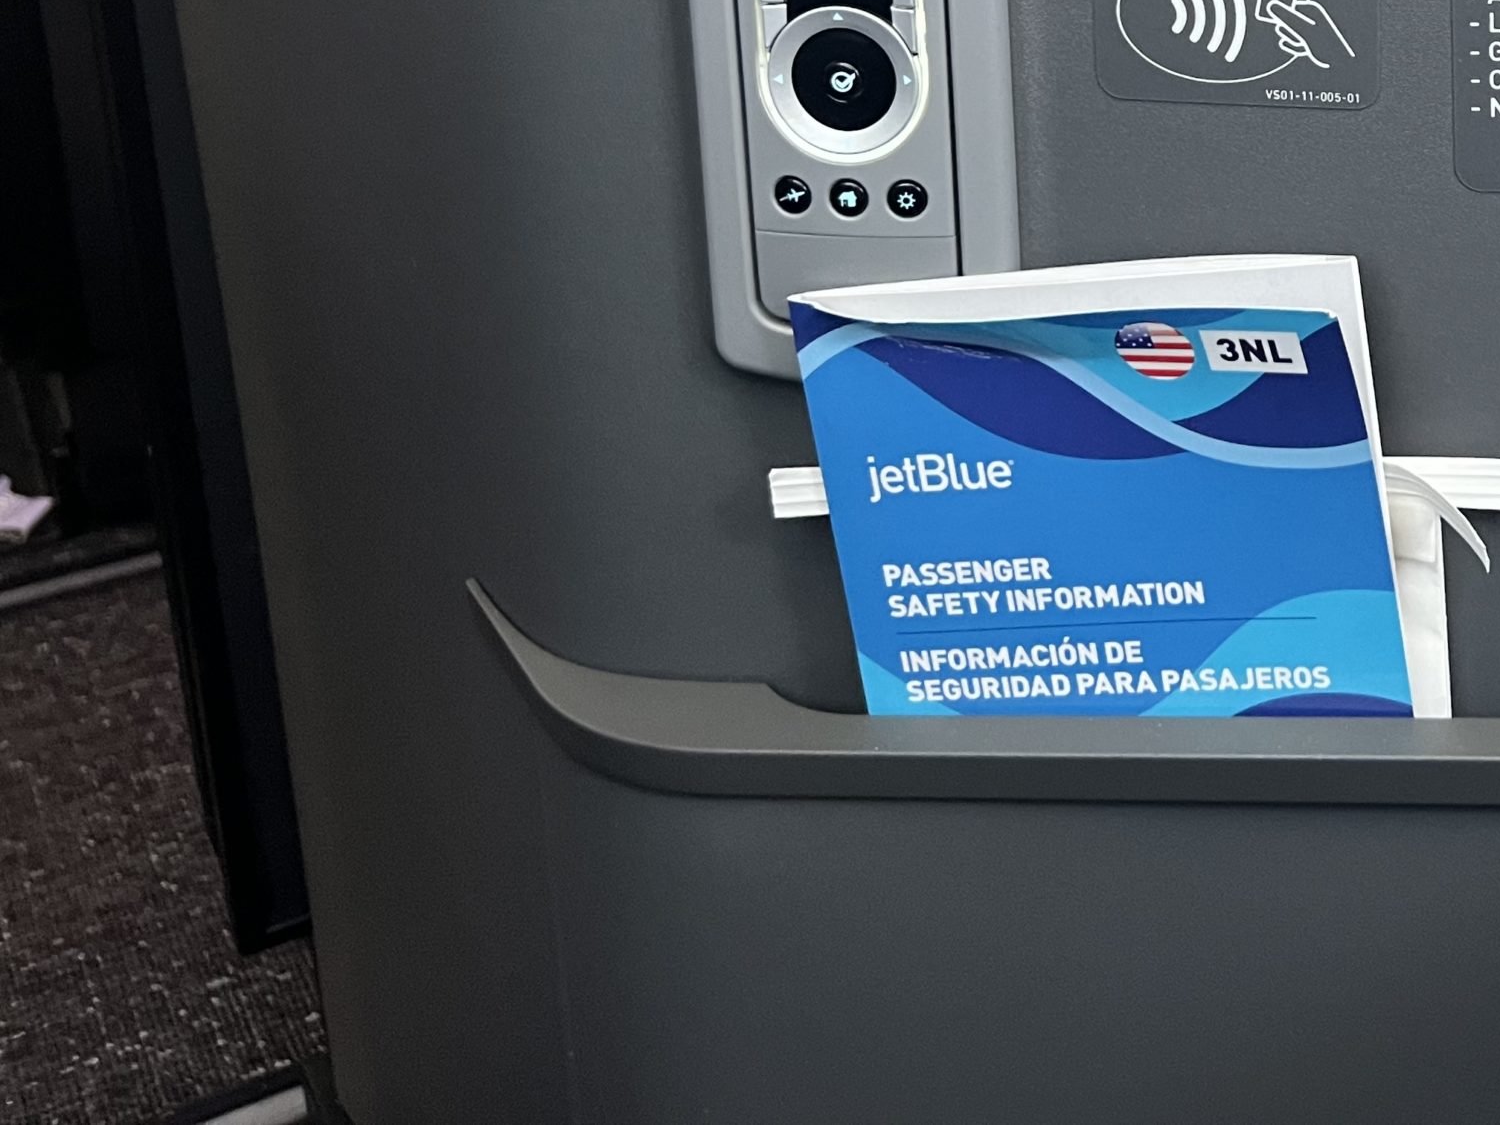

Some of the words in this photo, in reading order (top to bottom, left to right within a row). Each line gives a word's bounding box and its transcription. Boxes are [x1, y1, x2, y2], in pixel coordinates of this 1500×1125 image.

[1264, 88, 1361, 104] VS01-11-005-01
[1215, 337, 1293, 364] 3NL
[866, 452, 1013, 504] jetBlue
[881, 556, 1053, 588] PASSENGER
[888, 589, 1001, 618] SAFETY
[1005, 580, 1206, 613] INFORMATION
[899, 635, 1100, 674] INFORMACIÓN
[1104, 639, 1144, 665] DE
[905, 671, 1072, 704] SEGURIDAD
[1076, 669, 1158, 696] PARA
[1160, 665, 1332, 695] PASAJEROS
